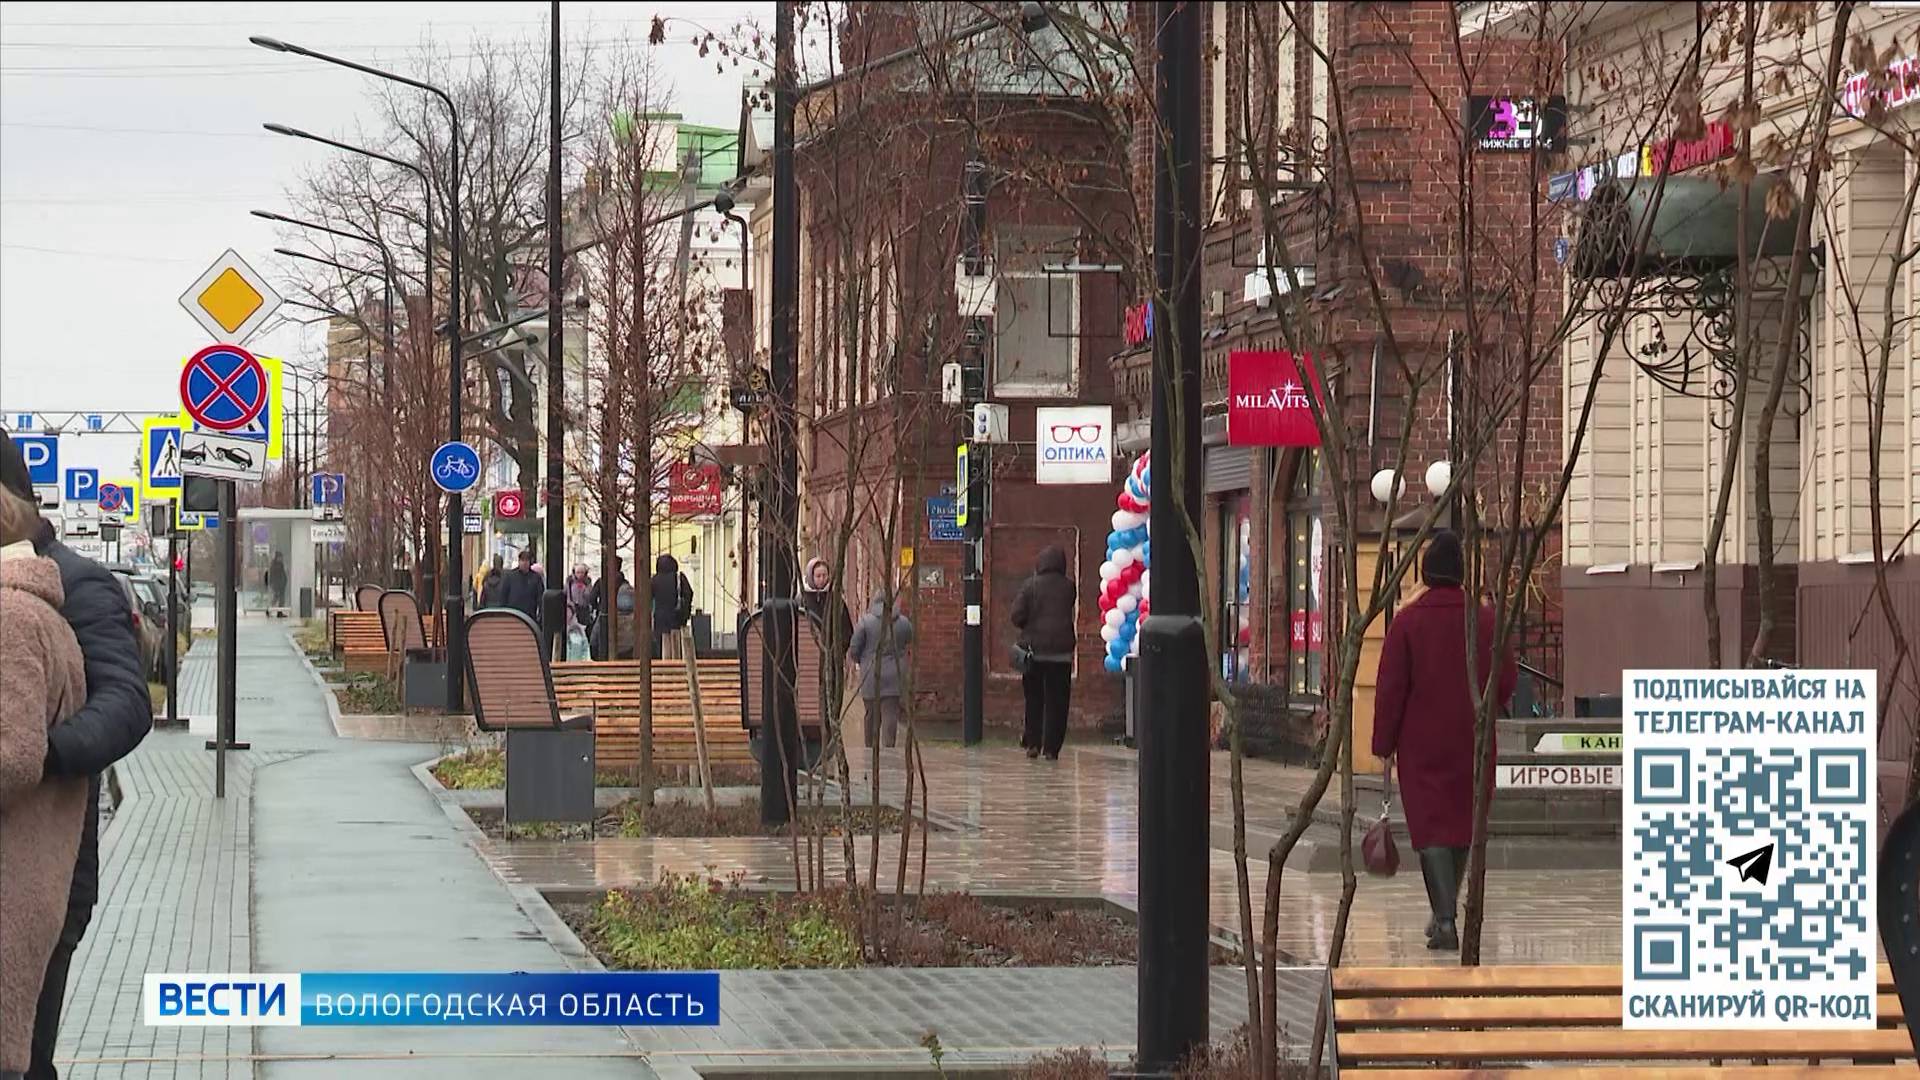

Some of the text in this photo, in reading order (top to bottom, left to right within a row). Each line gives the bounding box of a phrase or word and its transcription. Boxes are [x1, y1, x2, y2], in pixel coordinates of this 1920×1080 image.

[1236, 388, 1320, 411] MILAVITS
[1045, 447, 1106, 460] ОПТИКА
[74, 471, 93, 498] P
[1294, 621, 1305, 641] SALE
[1510, 767, 1613, 784] ИГРОВЫЕ
